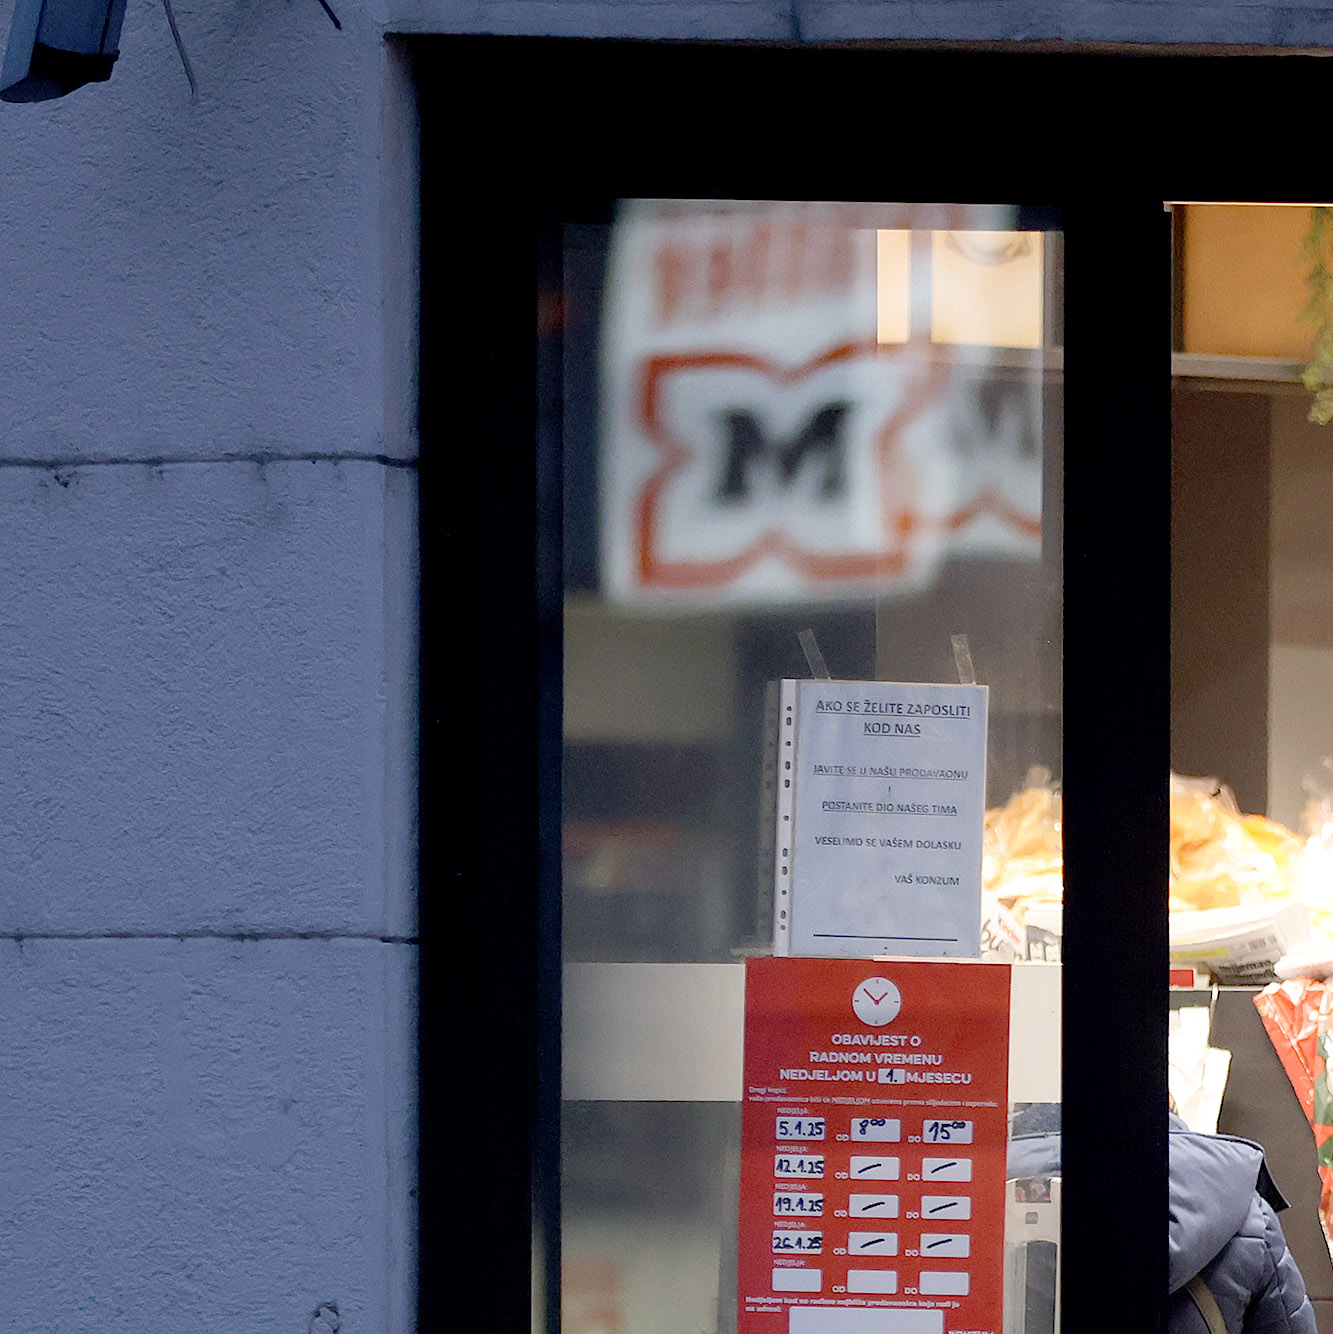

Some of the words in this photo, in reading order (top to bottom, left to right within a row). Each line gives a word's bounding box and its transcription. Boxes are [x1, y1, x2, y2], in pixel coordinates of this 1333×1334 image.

[816, 700, 843, 713] AKO
[847, 701, 861, 713] SE
[864, 699, 903, 715] ŽELITE
[907, 703, 970, 717] ZAPOSLITI
[864, 722, 891, 735] KOD
[894, 723, 921, 735] NAS
[813, 764, 844, 775] JAVITE
[847, 765, 858, 776] SE
[860, 766, 867, 777] U
[871, 764, 897, 777] NAŠU
[822, 800, 873, 812] POSTANITE
[876, 802, 894, 812] DIO
[897, 800, 929, 814] NAŠEG
[932, 804, 957, 815] TIMA
[815, 836, 863, 847] VESELIMO
[866, 838, 877, 848] SE
[879, 836, 913, 848] VAŠEM
[916, 839, 962, 850] DOLASKU
[894, 873, 913, 885] VAŠ
[916, 875, 960, 886] KONZUM
[831, 1034, 907, 1047] OBAVIJEST
[909, 1035, 922, 1047] O
[809, 1051, 871, 1064] RADNOM
[874, 1053, 943, 1065] VREMENU
[780, 1069, 863, 1082] NEDJELJOM
[866, 1071, 876, 1082] U
[906, 1072, 972, 1084] MJESECU
[779, 1121, 825, 1137] 5.1.25
[776, 1158, 825, 1174] 12.1.25
[775, 1196, 824, 1213] 19.1.25
